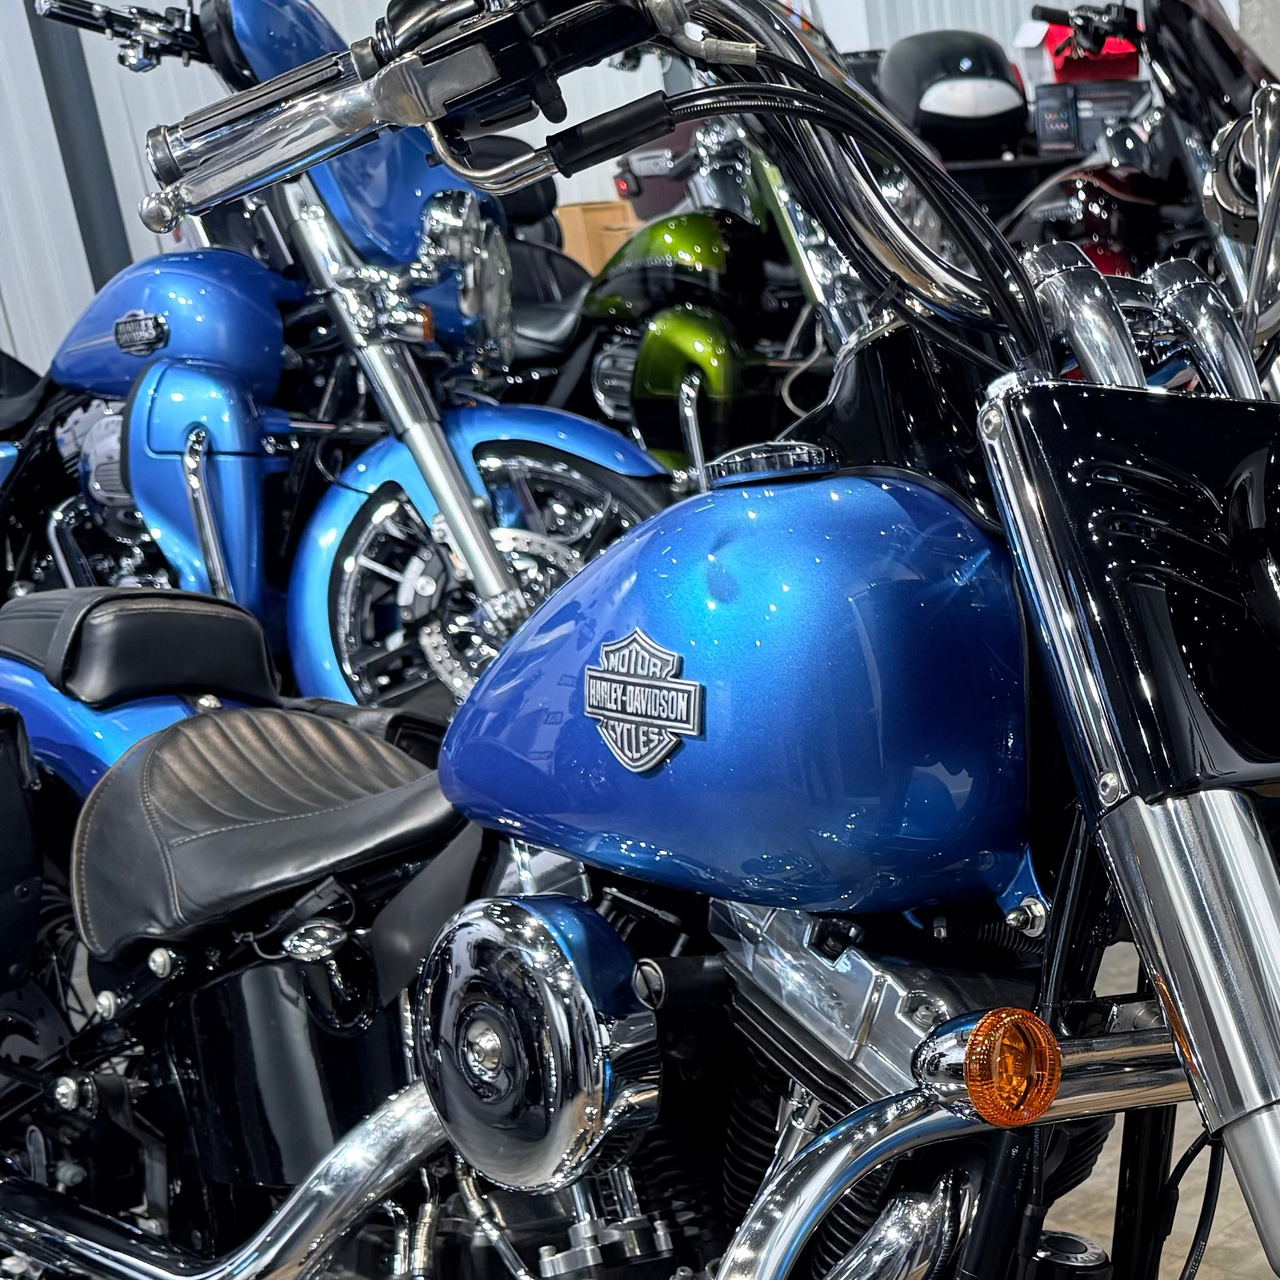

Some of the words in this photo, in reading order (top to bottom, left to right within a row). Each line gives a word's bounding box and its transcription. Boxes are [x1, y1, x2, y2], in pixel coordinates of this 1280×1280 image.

[608, 647, 662, 678] MOTOR
[589, 679, 689, 722] HARLEY-DAVIDSON
[608, 721, 662, 760] CYCLES
